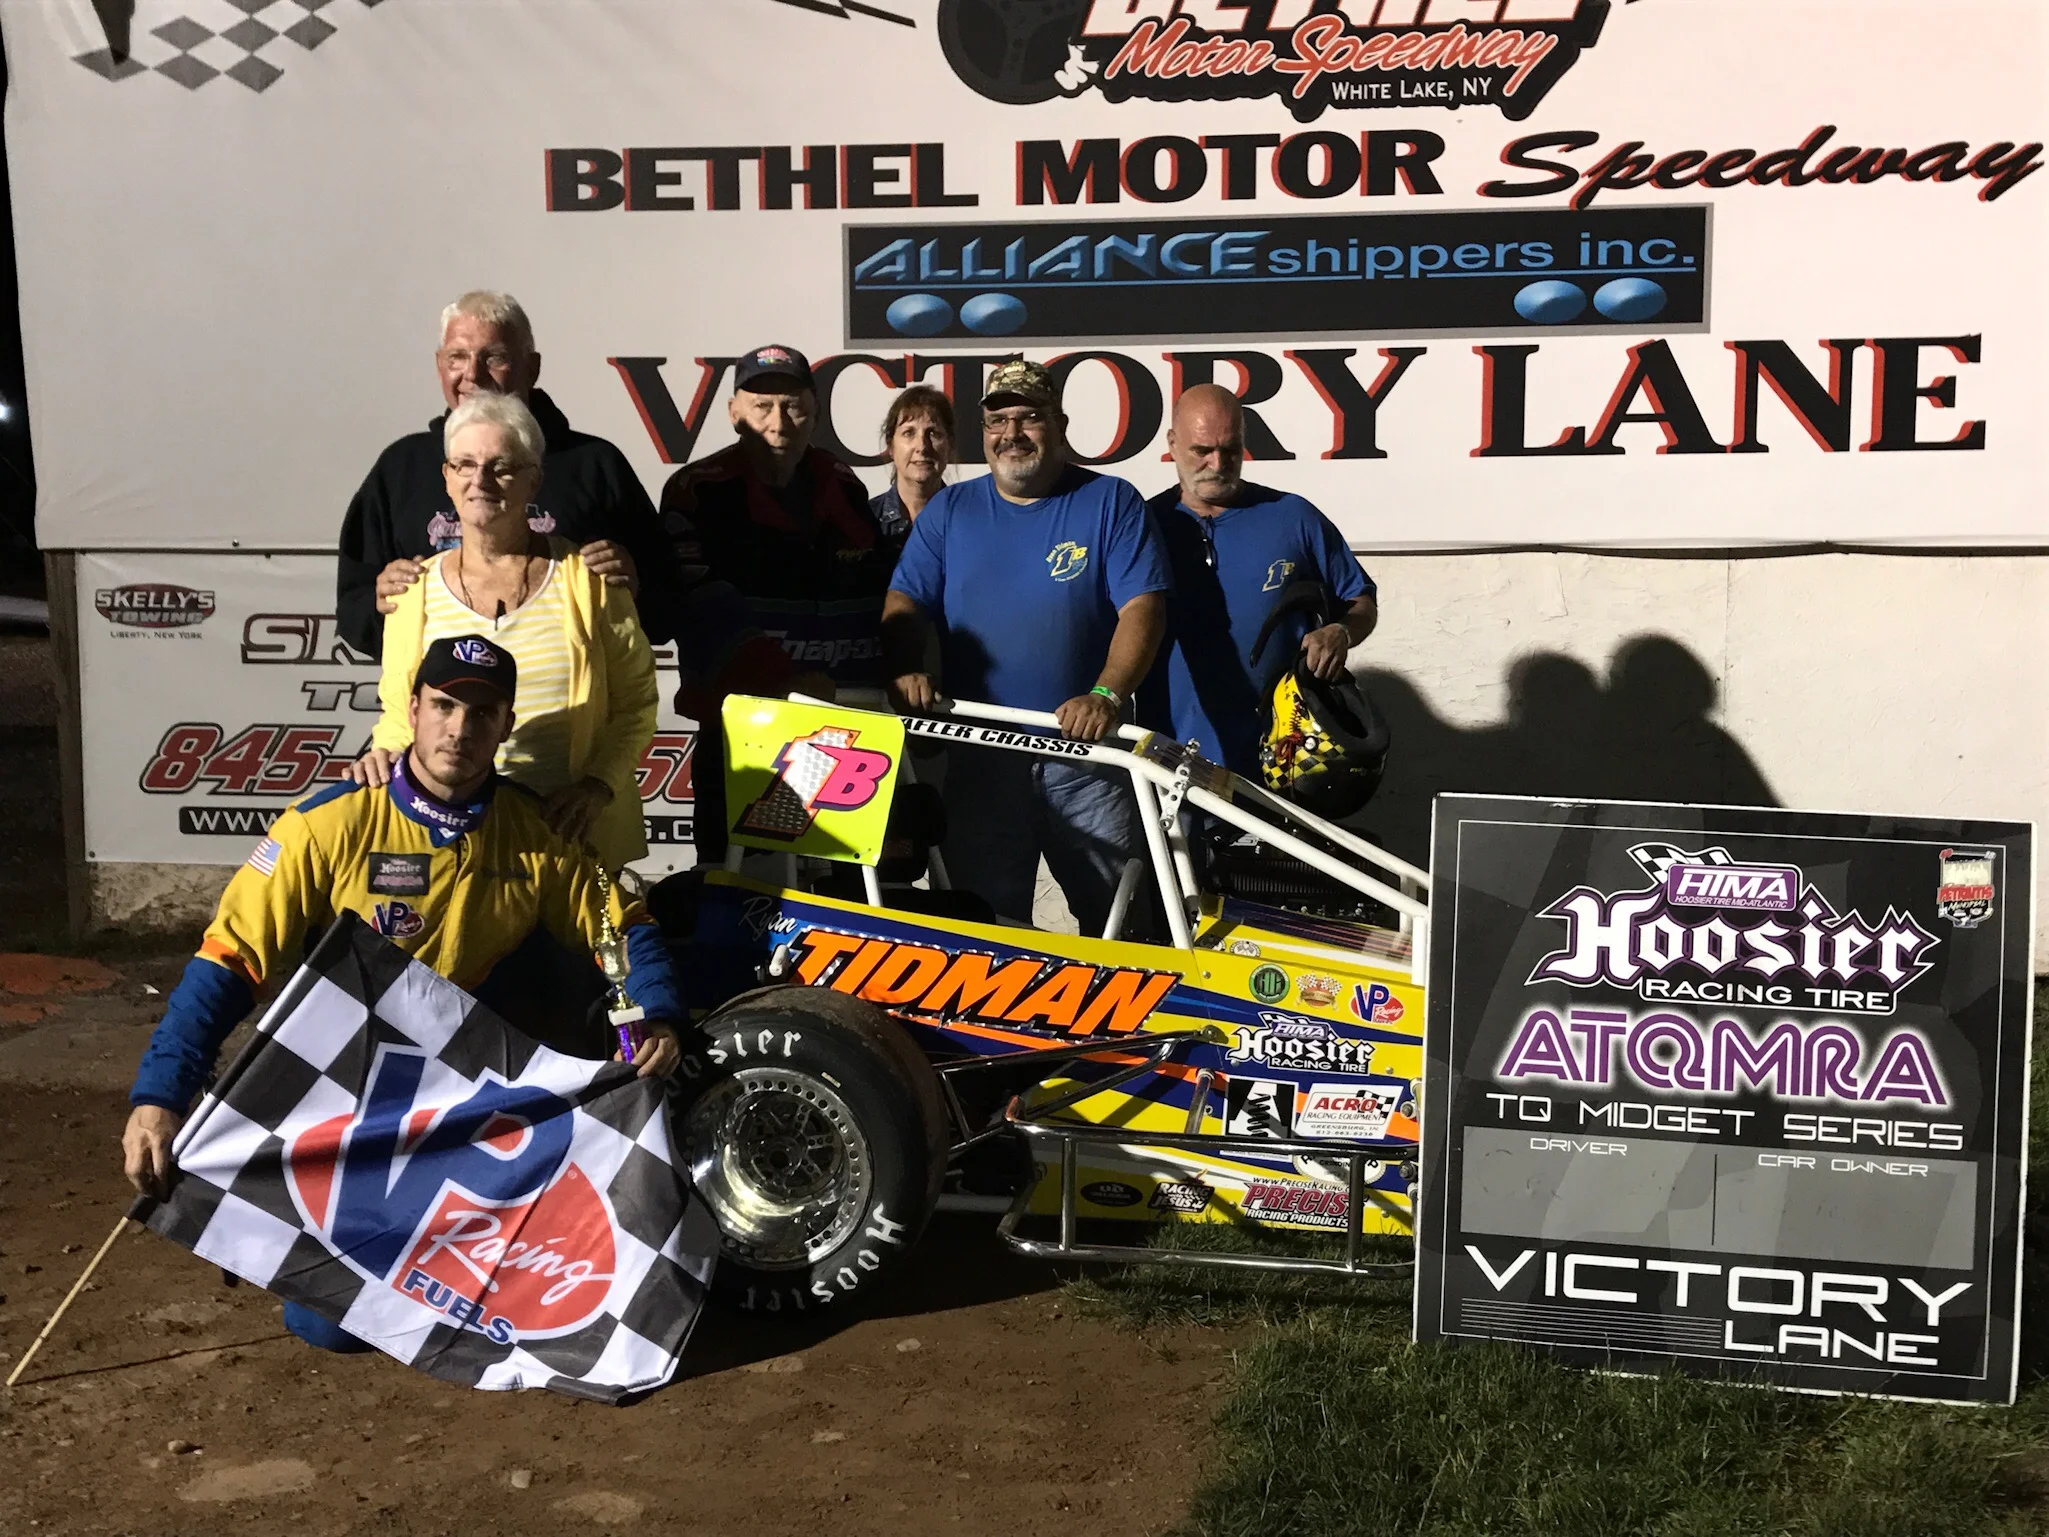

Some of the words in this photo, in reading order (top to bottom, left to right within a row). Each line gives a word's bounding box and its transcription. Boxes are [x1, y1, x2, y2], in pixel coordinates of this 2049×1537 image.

[1105, 18, 1275, 80] Motor
[1275, 13, 1560, 99] Speedway
[1331, 81, 1392, 101] WHITE
[1462, 76, 1494, 98] NY
[544, 142, 979, 212] BETHEL
[1016, 130, 1446, 206] MOTOR
[1476, 124, 2046, 211] Speedway
[855, 230, 1273, 282] ALLIANCE
[1267, 238, 1555, 280] shippers
[1578, 232, 1697, 266] inc.
[606, 346, 1428, 467] VCTORY
[1469, 333, 1988, 458] LANE
[95, 589, 215, 609] SKELLY'S
[110, 611, 205, 623] TOWING
[902, 717, 974, 739] AFLER
[979, 729, 1093, 756] CHASSIS
[410, 796, 469, 827] Hoosier
[374, 900, 410, 937] VP
[738, 896, 800, 942] Ryan
[1674, 895, 1714, 905] HOOSIER
[1731, 898, 1788, 909] MID-ATLANTIC
[1551, 893, 1932, 984] Hoosier
[796, 928, 1184, 1037] TIDMAN
[1644, 977, 1793, 1006] RACING
[1806, 988, 1892, 1012] TIRE
[1353, 982, 1391, 1023] VP
[664, 1028, 803, 1099] oosier
[1228, 1027, 1373, 1064] Hoosier
[1497, 1009, 1950, 1107] ATQMRA
[1271, 1057, 1332, 1071] RACING
[1338, 1062, 1367, 1073] TIRE
[1306, 1111, 1337, 1120] RACING
[1338, 1112, 1383, 1121] EQUIPMENT
[1313, 1097, 1378, 1112] ACRO
[1485, 1093, 1553, 1122] TQ
[1578, 1100, 1756, 1137] MIDGET
[1782, 1114, 1965, 1152] SERIES
[330, 1049, 576, 1282] VP
[1530, 1137, 1628, 1157] DRIVER
[1757, 1153, 1818, 1170] CAR
[1830, 1158, 1929, 1178] OWNER
[1150, 1196, 1193, 1208] JESUS
[1157, 1183, 1210, 1197] RACING
[1241, 1183, 1349, 1217] PRECIS
[1247, 1208, 1290, 1221] RACING
[1289, 1212, 1349, 1228] PRODUCTS
[419, 1209, 616, 1306] Racing
[1462, 1244, 1974, 1327] VICTORY
[401, 1268, 517, 1346] FUELS
[1723, 1318, 1940, 1367] LANE
